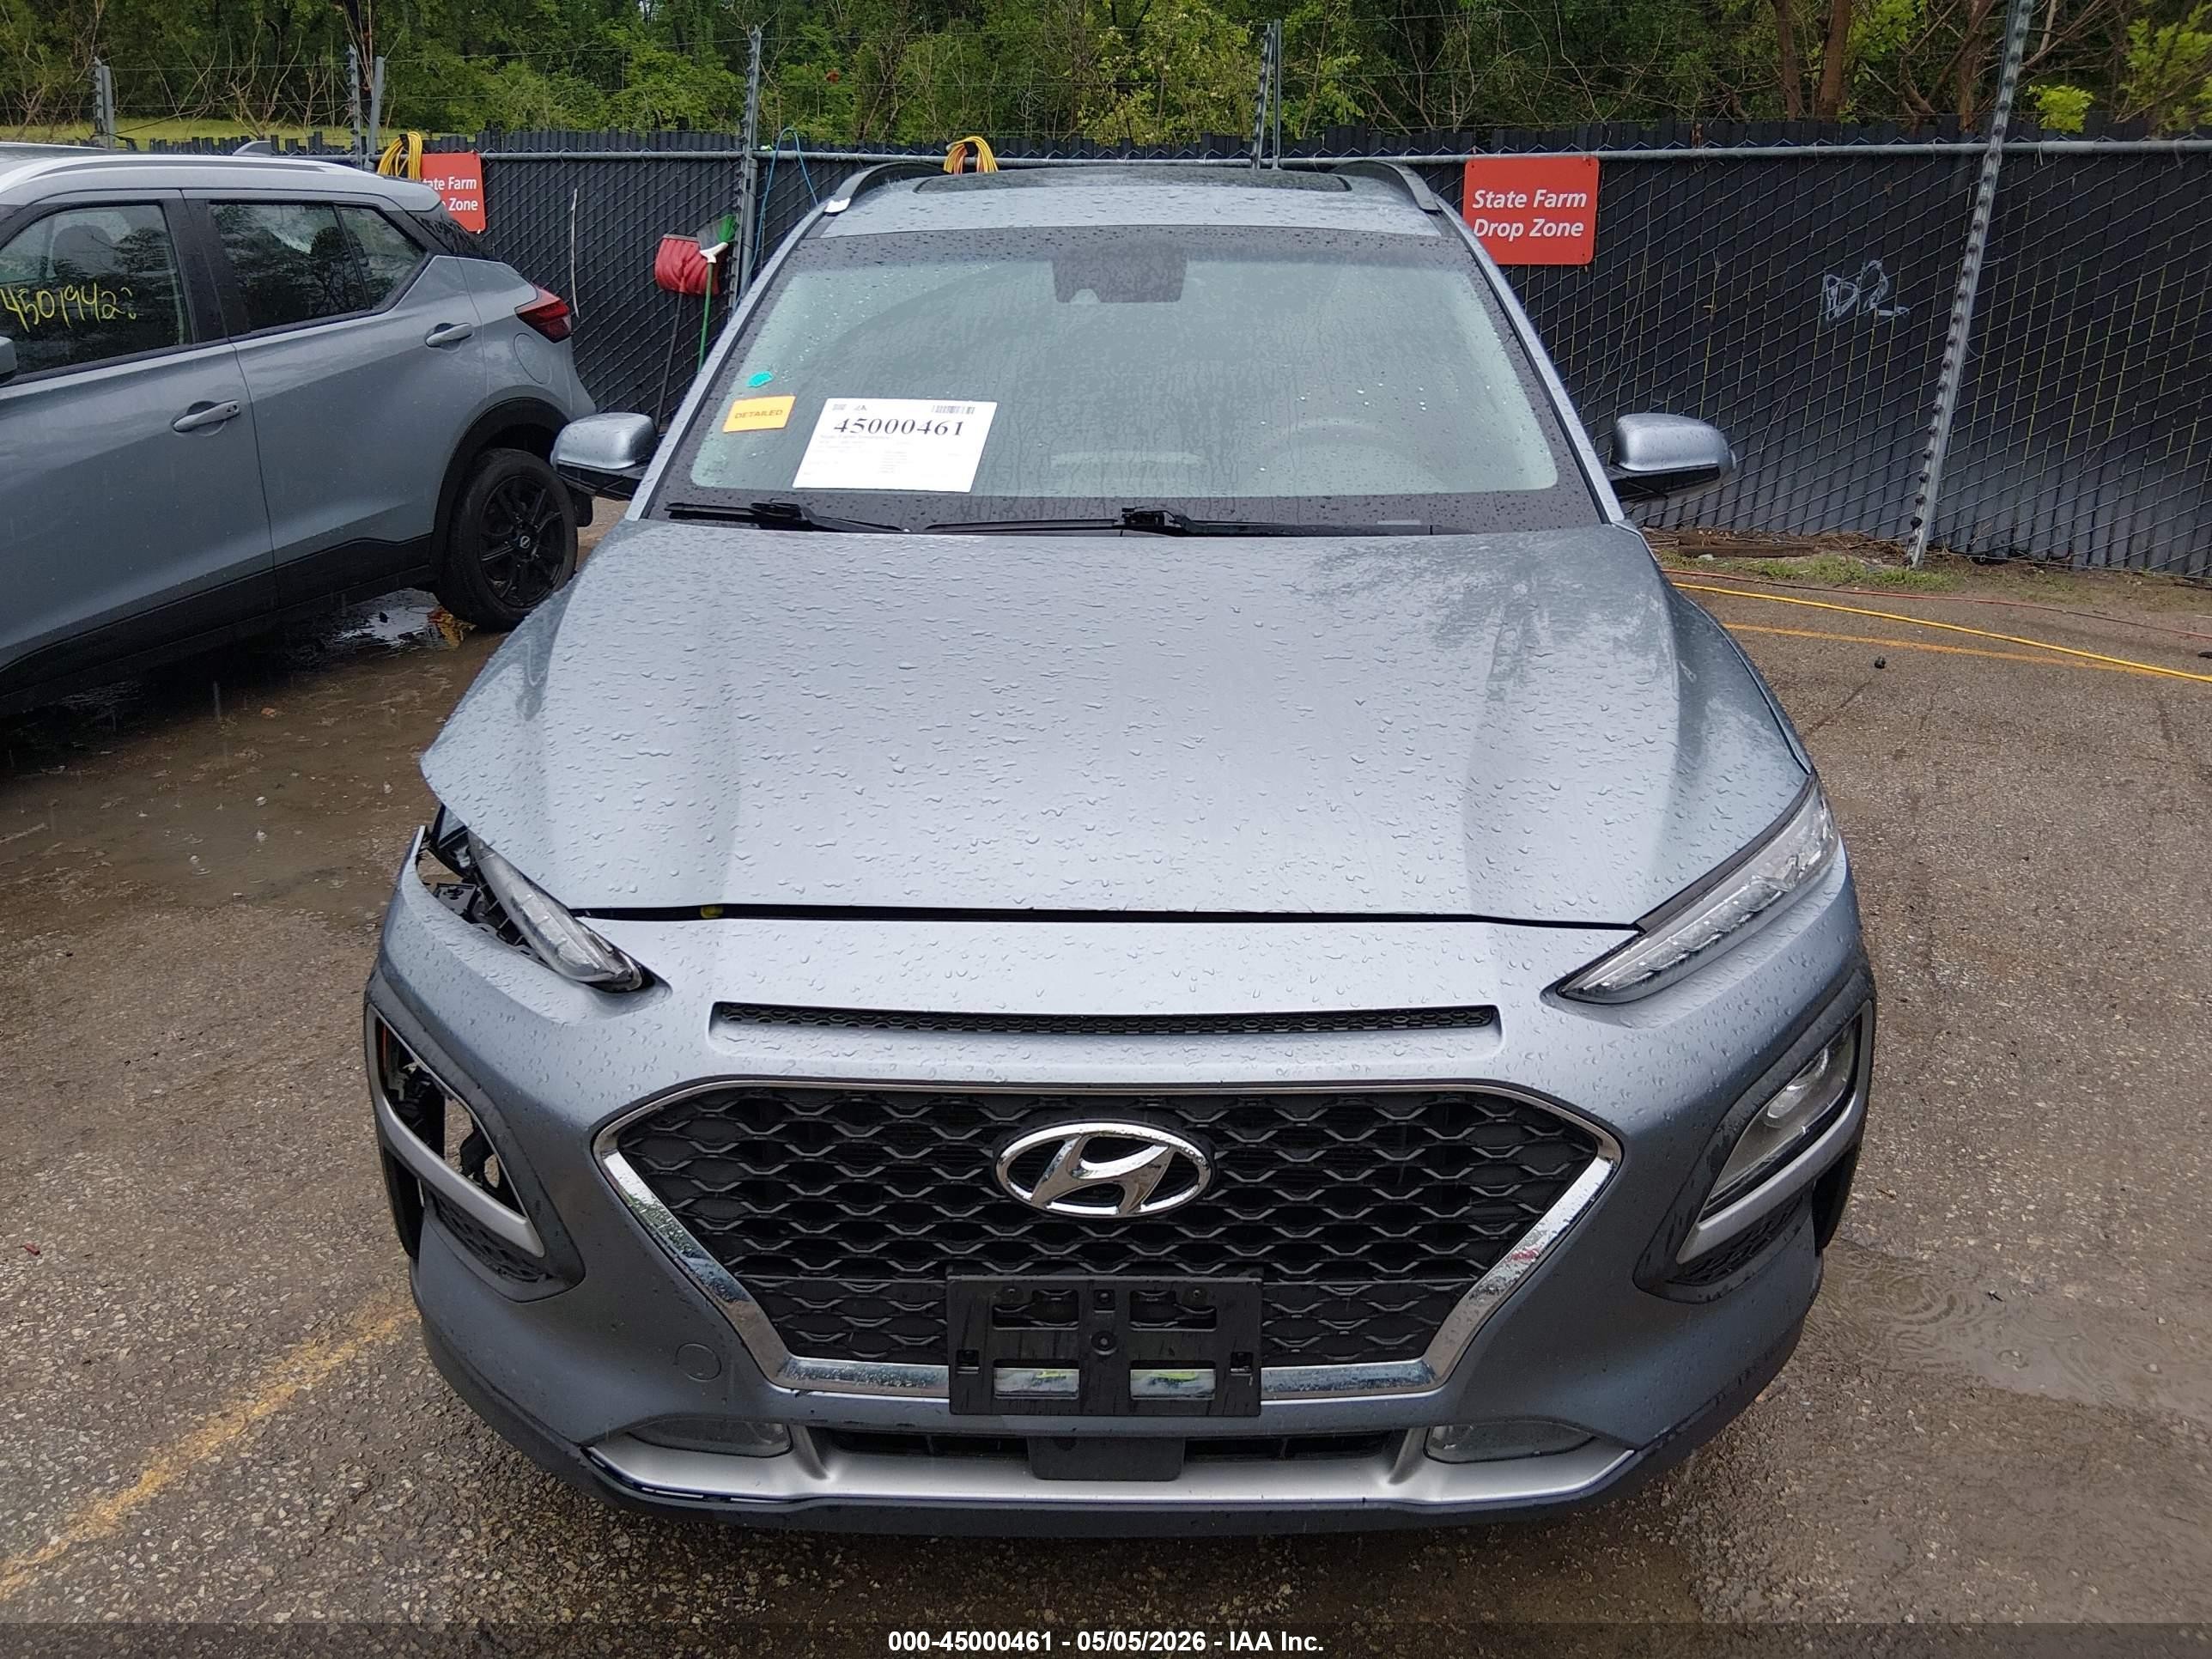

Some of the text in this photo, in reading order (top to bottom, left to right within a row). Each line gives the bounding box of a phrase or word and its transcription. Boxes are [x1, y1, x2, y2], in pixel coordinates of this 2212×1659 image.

[422, 176, 477, 190] tate Farm
[448, 198, 478, 211] Zone
[1472, 189, 1588, 209] State Farm
[1473, 218, 1584, 242] Drop Zone
[734, 409, 783, 419] DETAILED
[833, 417, 963, 436] 45000461
